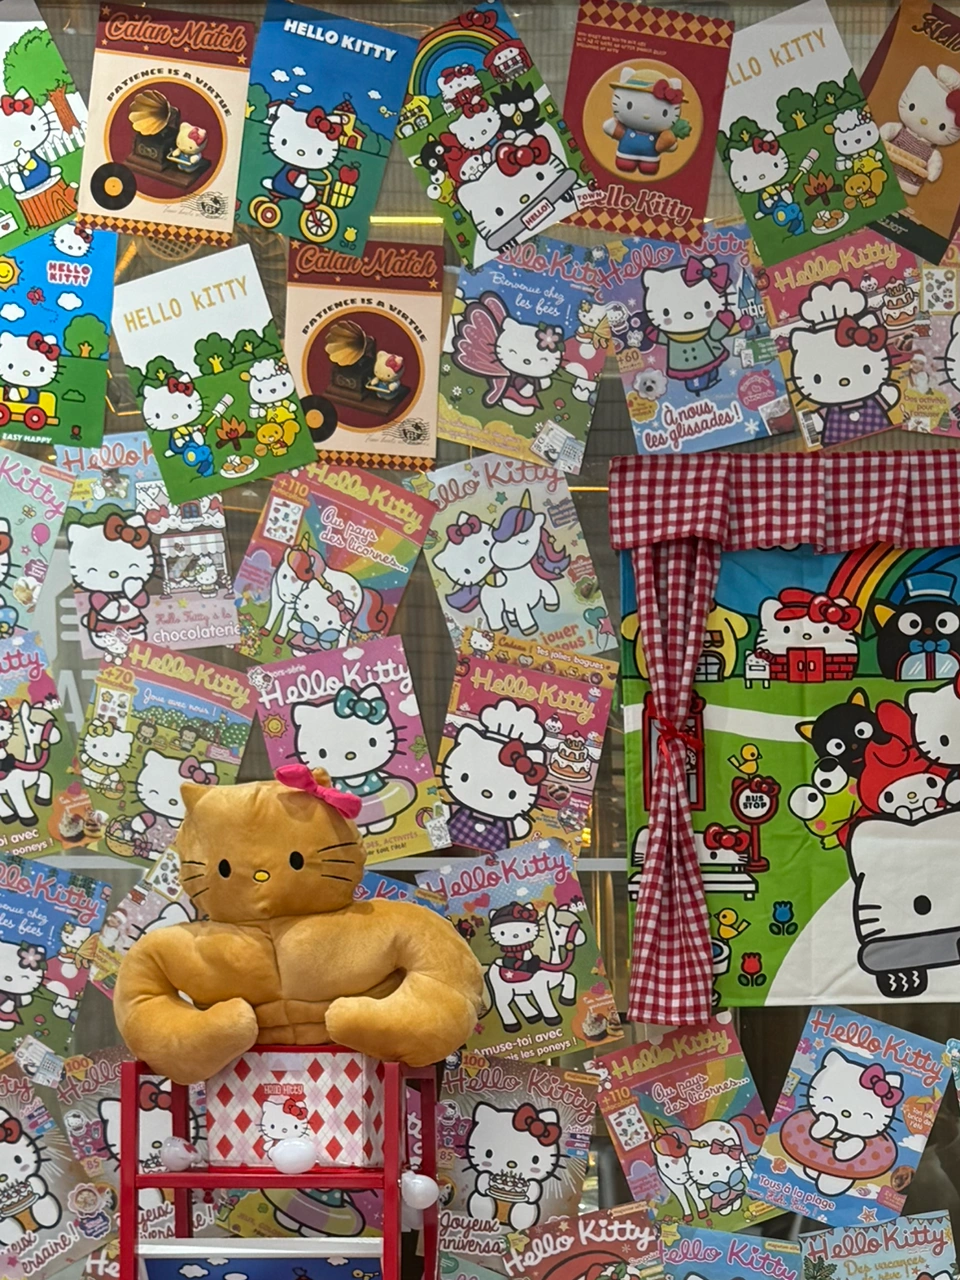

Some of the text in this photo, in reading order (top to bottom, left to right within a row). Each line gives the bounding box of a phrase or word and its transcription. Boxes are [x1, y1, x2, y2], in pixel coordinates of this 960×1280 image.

[170, 20, 248, 53] Match
[283, 18, 398, 62] HELLO KITTY
[106, 67, 233, 118] PATIENCE IS VIRTUE
[576, 190, 604, 202] TOWN
[636, 188, 694, 225] Kitty
[524, 200, 553, 229] HELLO!
[47, 261, 92, 275] HELLO
[48, 273, 91, 287] KITTY
[360, 250, 437, 278] Match
[601, 245, 675, 289] Hello
[774, 241, 902, 293] Hello Kitty
[489, 270, 566, 305] Bienvenue chez
[514, 294, 534, 311] les
[124, 297, 183, 333] HELLO
[301, 298, 429, 343] PATIENCE IS VIRTUE
[618, 350, 640, 365] +60
[675, 401, 714, 422] nous
[2, 432, 53, 445] EASY HAPPY
[645, 412, 734, 451] les glissades
[62, 442, 143, 474] Hello
[0, 455, 67, 522] Kitty
[300, 463, 425, 533] Hello Kitty
[348, 521, 380, 546] pays
[152, 620, 241, 645] chocolaterie
[104, 668, 133, 685] +70
[128, 643, 251, 709] Hello Kitty
[257, 657, 413, 710] Hello Kitty
[470, 666, 596, 725] Hello Kitty
[743, 801, 768, 811] STOP
[744, 795, 766, 805] BUS
[426, 851, 572, 902] Hello Kitty
[33, 876, 102, 925] Kitty
[535, 1028, 564, 1049] avec
[610, 1027, 732, 1079] Hello Kitty
[810, 1009, 945, 1088] Hello Kitty
[57, 1060, 122, 1105] Hello
[442, 1065, 599, 1122] Hello Kitty
[602, 1087, 632, 1103] +110
[678, 1073, 709, 1096] pays
[758, 1174, 783, 1192] Tous
[503, 1233, 574, 1276] Hello
[578, 1219, 656, 1255] Kitty
[807, 1223, 949, 1263] Hello Kitty
